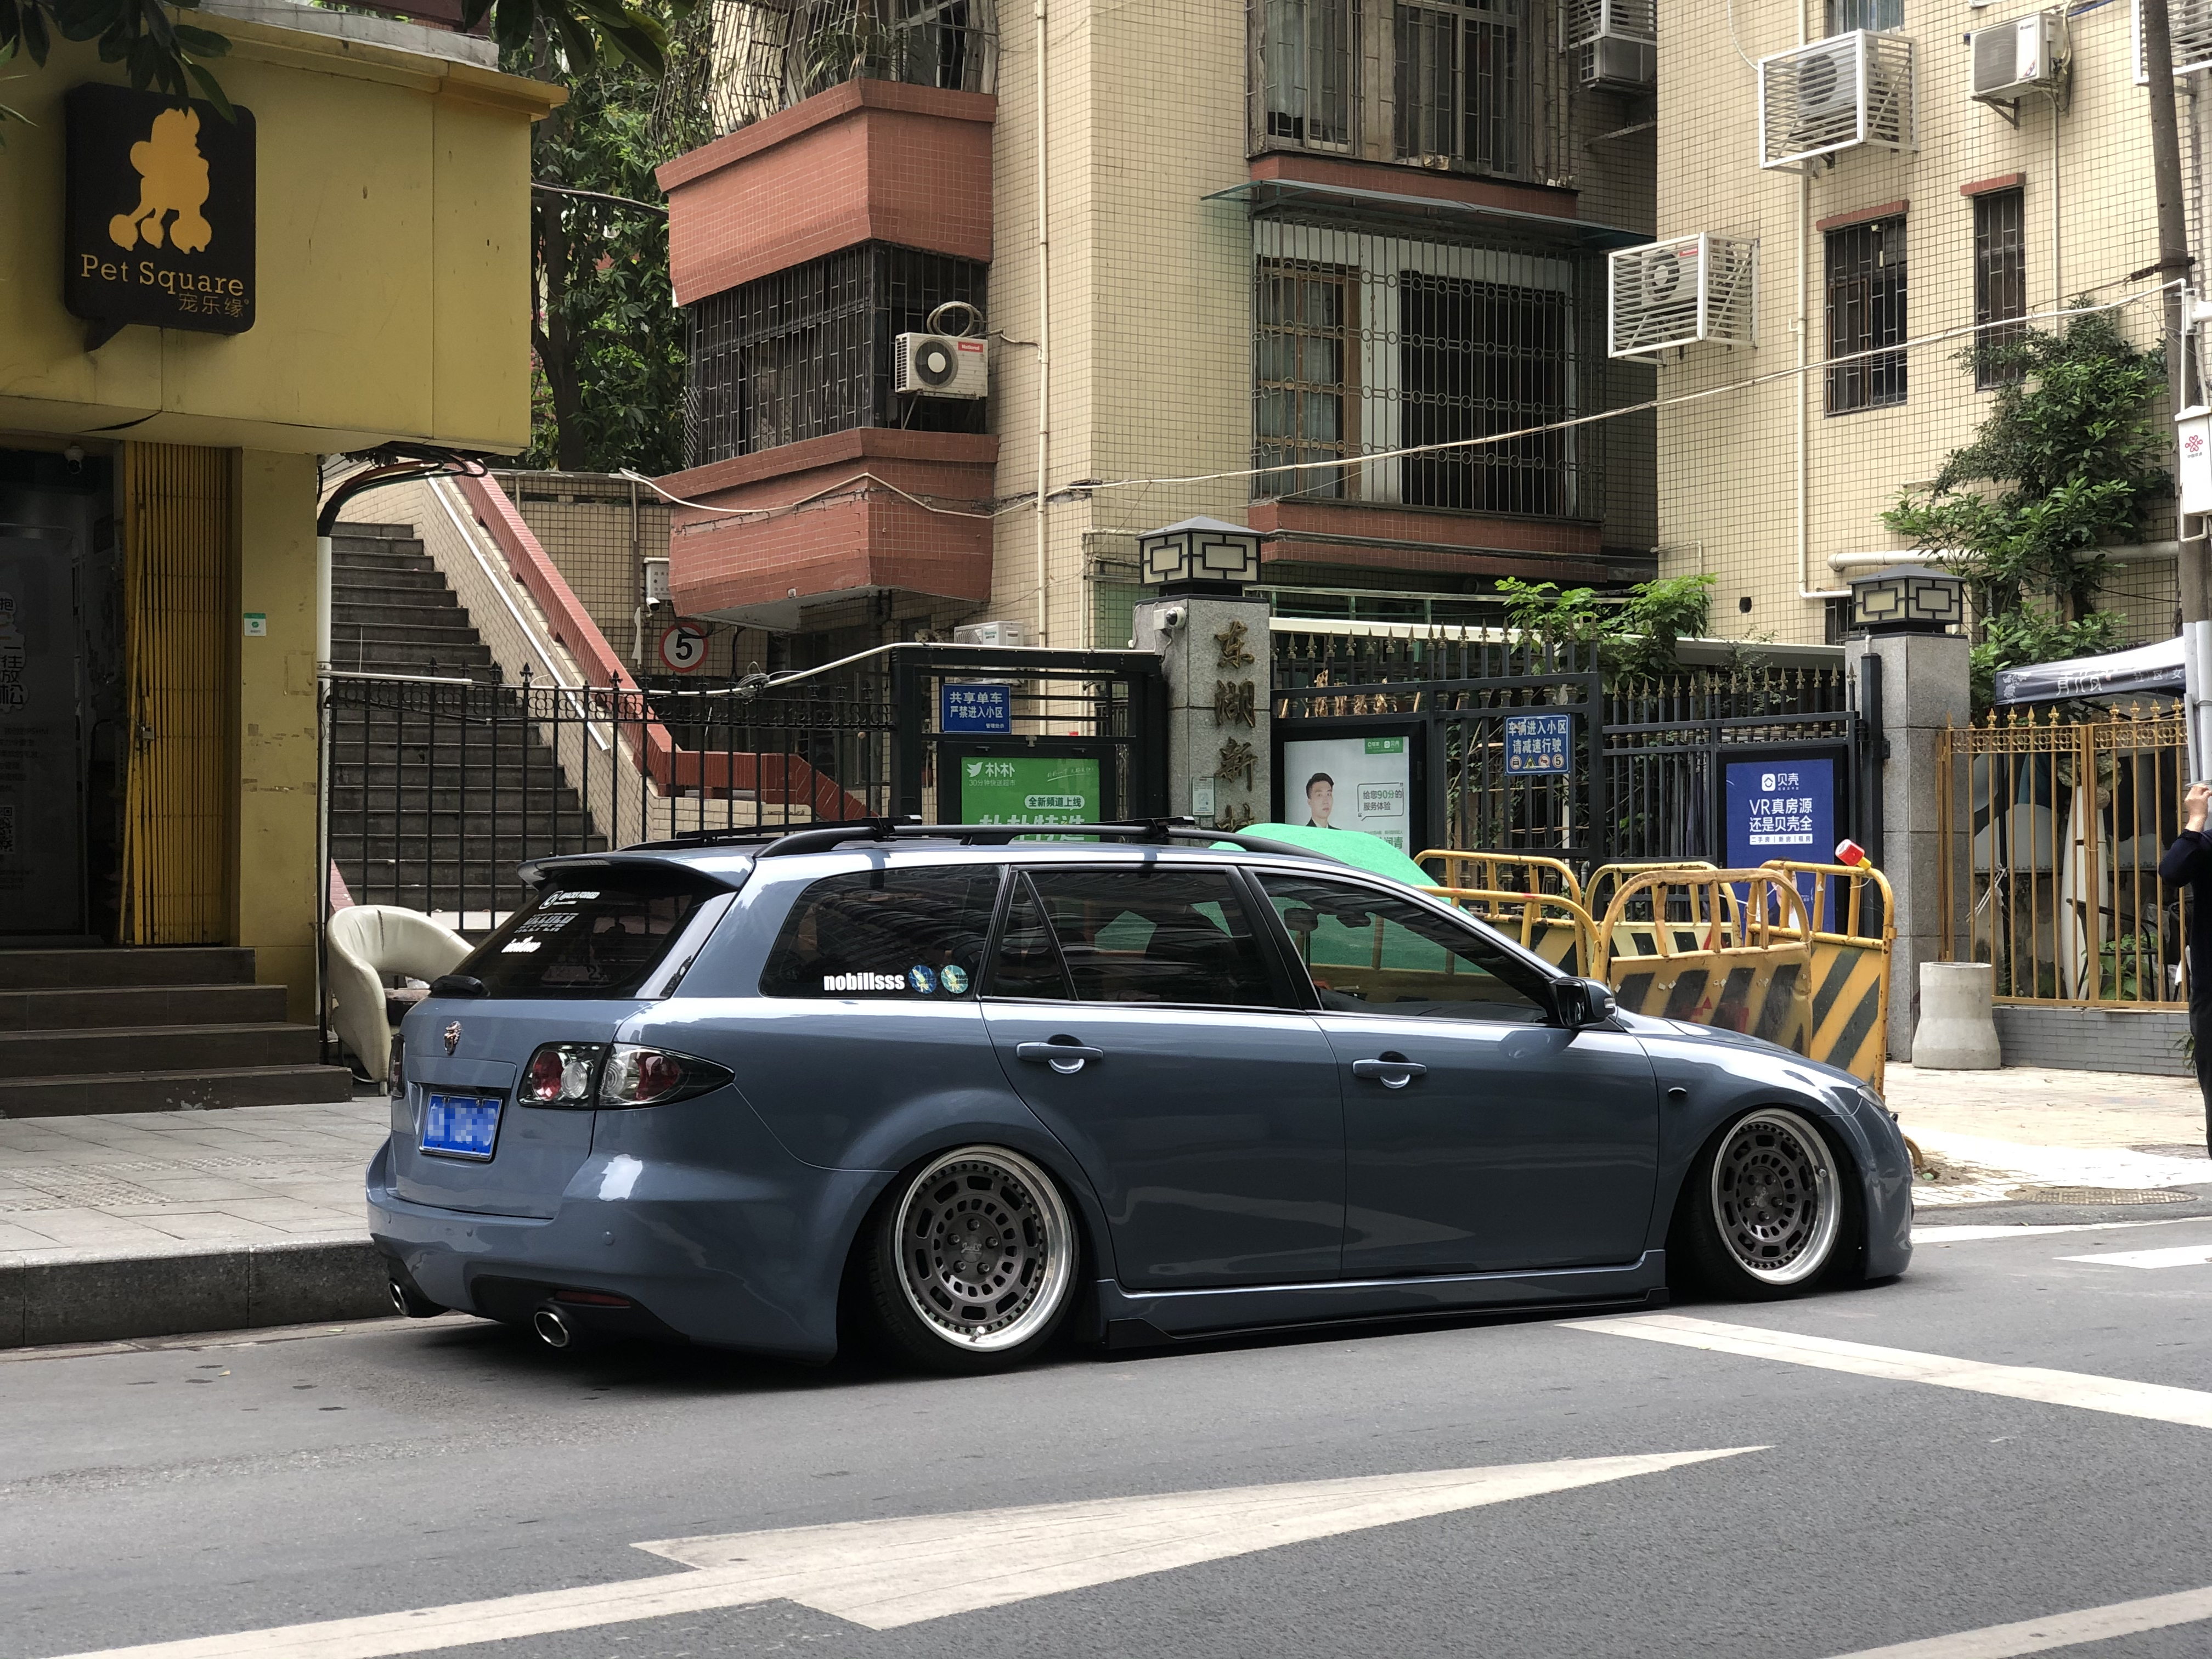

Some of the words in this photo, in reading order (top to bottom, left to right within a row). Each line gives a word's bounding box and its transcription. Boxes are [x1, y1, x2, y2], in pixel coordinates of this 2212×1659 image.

[81, 253, 129, 282] Pet
[139, 261, 244, 296] Square
[178, 292, 244, 318] 宠乐缘
[675, 634, 693, 661] 5
[949, 691, 1003, 704] 共享单车
[950, 706, 1003, 719] 严禁进入小区
[1508, 719, 1567, 736] 车辆进入小区
[1513, 737, 1562, 754] 请减速行驶
[1555, 756, 1561, 766] 5
[985, 762, 1015, 778] 朴朴
[1778, 772, 1799, 786] 贝壳
[1363, 789, 1402, 799] 给您90分的
[1028, 797, 1082, 808] 全新频道上线
[1363, 802, 1391, 811] 服务体验
[1749, 798, 1813, 815] VR真房源
[1749, 815, 1813, 832] 还是贝壳全
[1380, 836, 1404, 849] 润青
[823, 972, 905, 991] nobillsss
